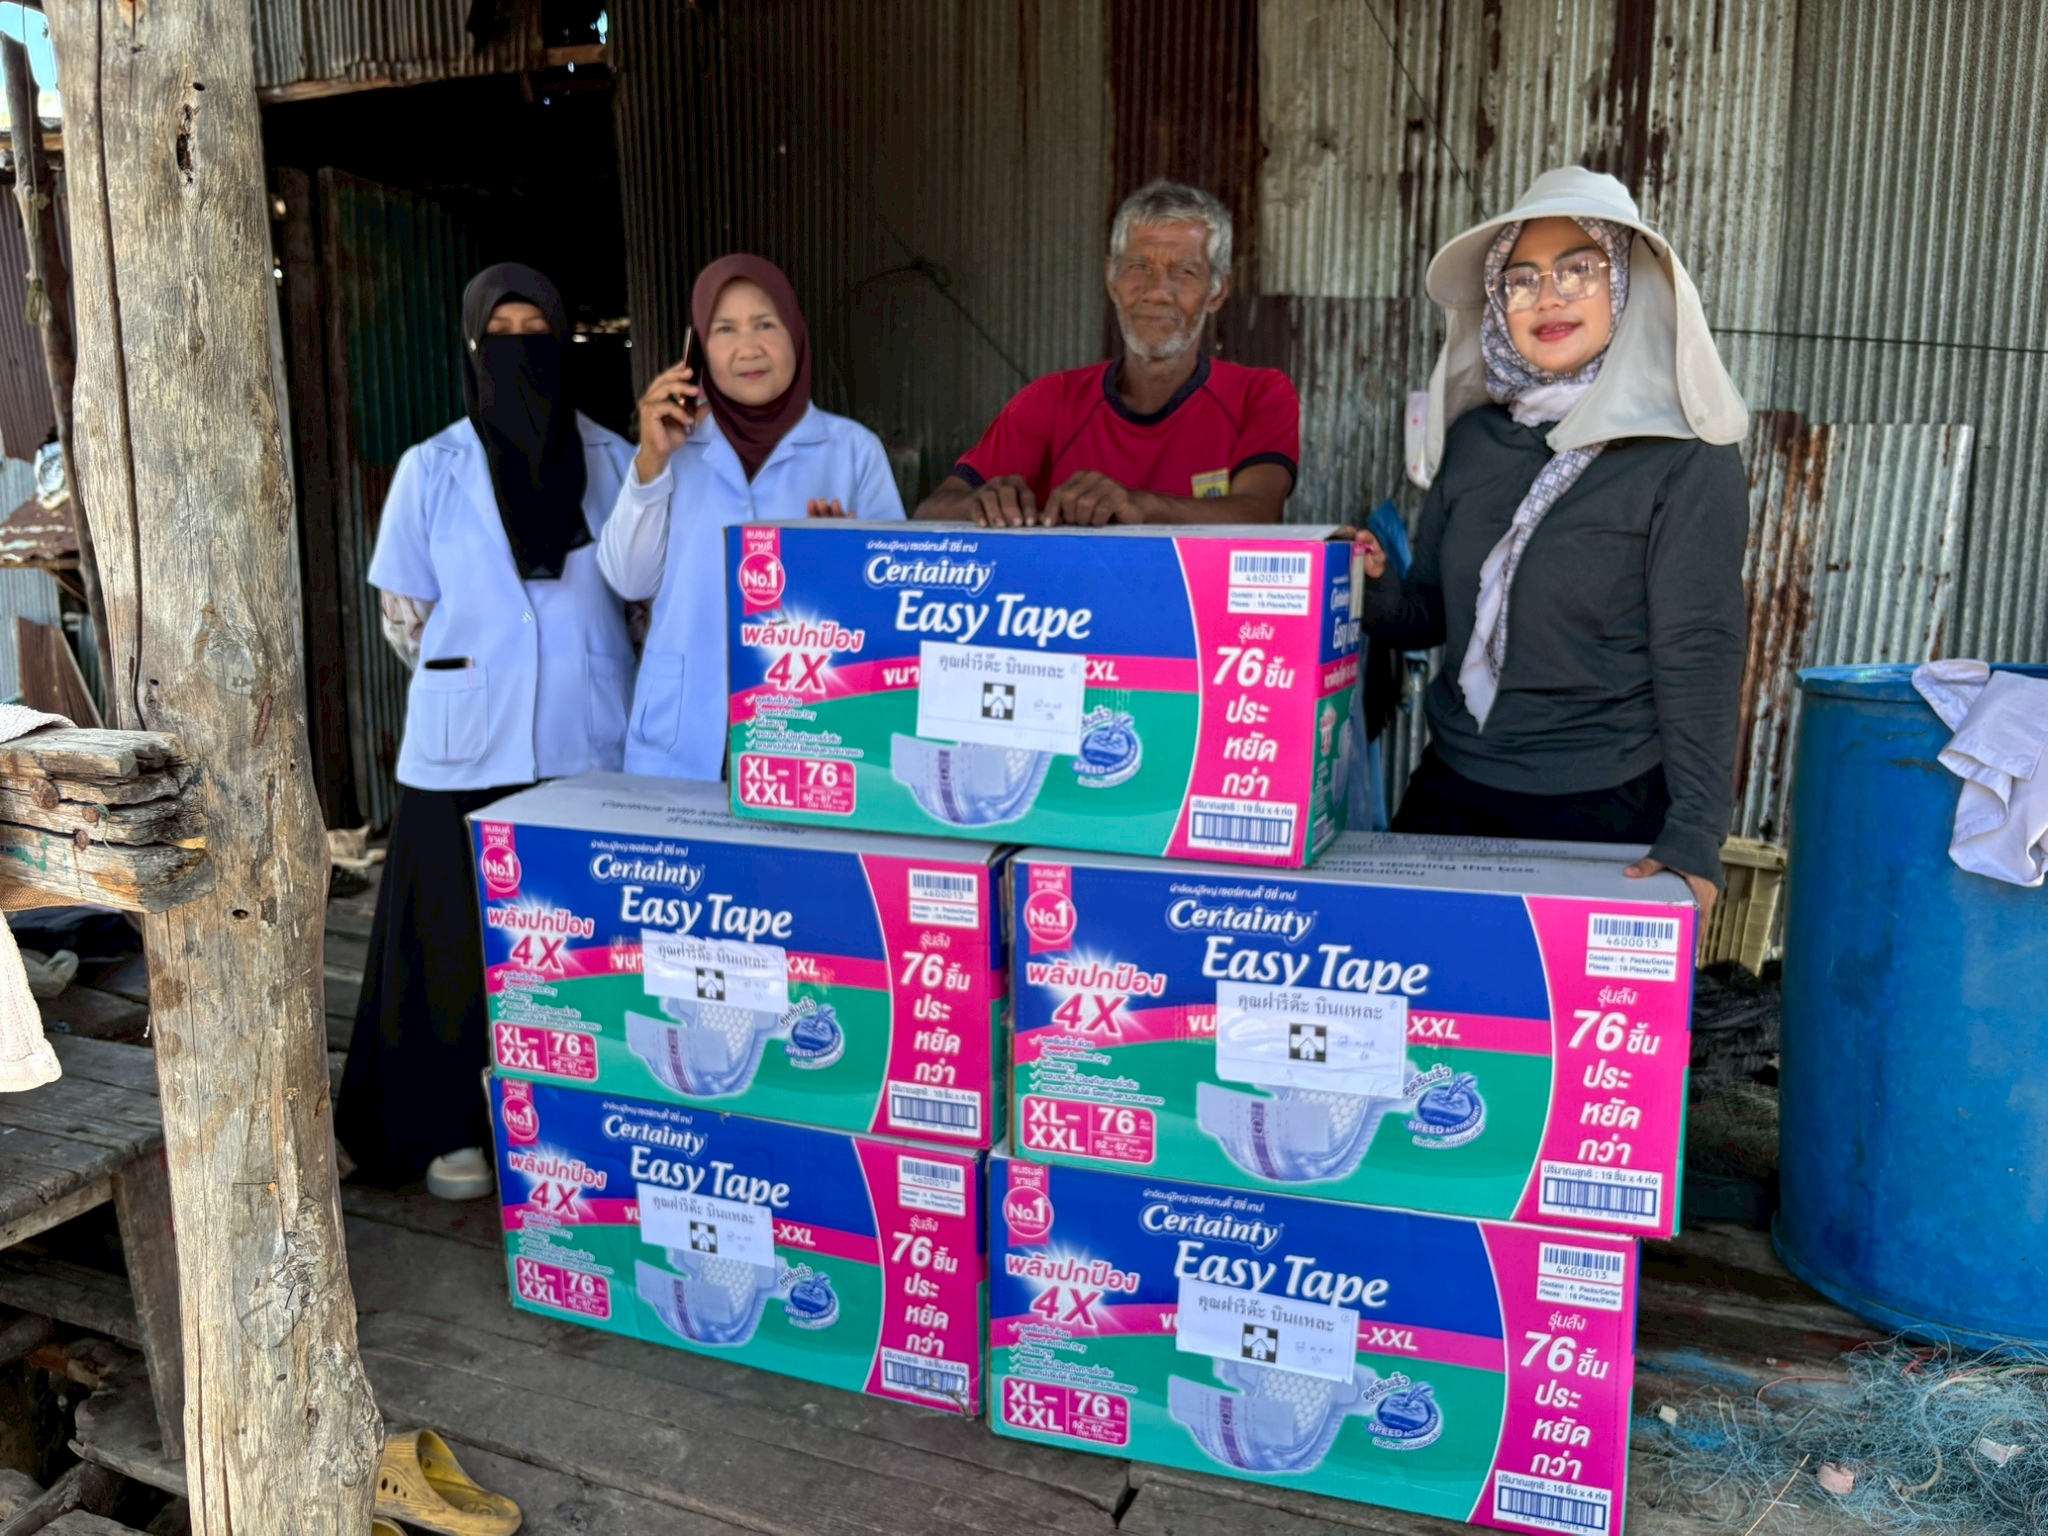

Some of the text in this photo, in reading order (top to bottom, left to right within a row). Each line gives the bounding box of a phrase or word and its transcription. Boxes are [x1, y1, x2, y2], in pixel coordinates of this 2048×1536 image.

[746, 560, 780, 588] No.1
[868, 555, 990, 592] Certainty
[895, 591, 1091, 647] Easy Tape
[742, 621, 864, 651] พลังปกป้อง
[767, 653, 830, 692] 4X
[883, 668, 920, 686] ขนา
[1214, 647, 1264, 686] 76
[1264, 656, 1294, 688] ชิ้น
[1226, 694, 1269, 724] ประ
[1224, 732, 1277, 762] หยัด
[806, 760, 837, 787] 76
[1222, 767, 1269, 796] กว่า
[744, 780, 794, 806] XXL
[1243, 802, 1252, 811] 19
[484, 850, 515, 876] No.1
[592, 854, 701, 890] Certainty
[489, 904, 593, 936] พลังปกป้อง
[620, 886, 792, 942] Easy Tape
[1028, 896, 1068, 927] No.1
[1171, 899, 1311, 941] Certainty
[510, 934, 566, 970] 4X
[1605, 935, 1659, 948] 4600013
[901, 952, 970, 991] 76 ชิ้น
[1028, 959, 1163, 994] พลังปกป้อง
[1202, 936, 1429, 995] Easy Tape
[914, 994, 951, 1020] ประ
[1054, 993, 1126, 1037] 4X
[550, 1030, 580, 1056] 76
[914, 1027, 960, 1054] หยัด
[1569, 1010, 1660, 1055] 76 ชิ้น
[500, 1045, 544, 1070] XXL
[914, 1058, 955, 1084] กว่า
[1583, 1059, 1631, 1089] ประ
[1098, 1107, 1135, 1134] 76
[1408, 1120, 1444, 1134] SPEED
[1580, 1098, 1640, 1129] หยัด
[604, 1114, 705, 1156] Certainty
[1029, 1124, 1085, 1152] XXL
[1578, 1134, 1631, 1165] กว่า
[509, 1151, 606, 1188] พลังปกป้อง
[630, 1145, 789, 1210] Easy Tape
[1601, 1170, 1611, 1179] 19
[530, 1180, 580, 1218] 4X
[1007, 1192, 1045, 1223] No.1
[1143, 1204, 1278, 1250] Certainty
[892, 1232, 957, 1273] 76 ชิ้น
[566, 1269, 594, 1295] 76
[904, 1272, 939, 1297] ประ
[1007, 1251, 1138, 1292] พลังปกป้อง
[1174, 1241, 1388, 1308] Easy Tape
[1556, 1264, 1607, 1280] 4600013
[520, 1278, 561, 1304] XXL
[1032, 1283, 1100, 1327] 4X
[905, 1304, 948, 1330] หยัด
[906, 1332, 944, 1356] กว่า
[1521, 1332, 1608, 1379] 76 ชิ้น
[1075, 1390, 1110, 1418] 76
[1535, 1380, 1581, 1408] ประ
[1008, 1402, 1063, 1431] XXL
[1369, 1422, 1402, 1437] SPEED
[1532, 1416, 1590, 1446] หยัด
[1530, 1450, 1581, 1480] กว่า
[1553, 1483, 1563, 1492] 19
